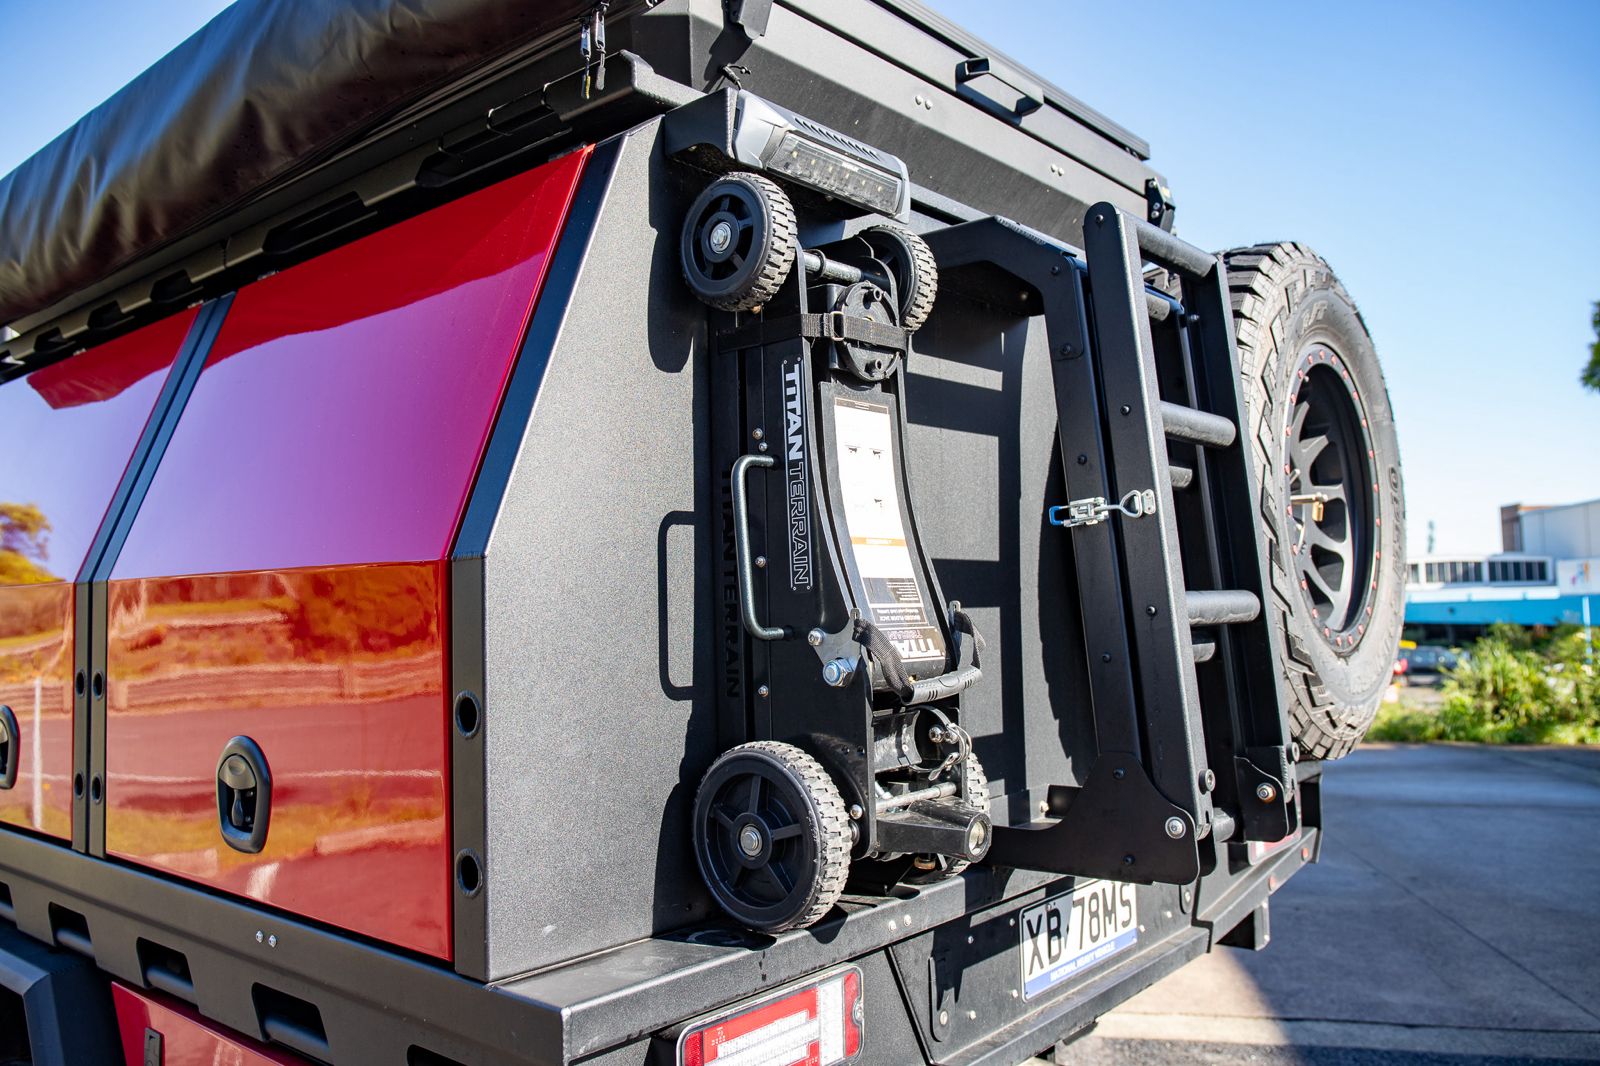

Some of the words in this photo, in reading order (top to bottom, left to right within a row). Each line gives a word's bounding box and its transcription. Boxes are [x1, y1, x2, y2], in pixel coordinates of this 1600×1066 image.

[784, 363, 804, 461] TITAN
[788, 462, 809, 585] TERRAIN
[723, 564, 740, 699] TERRAIN
[889, 638, 942, 659] TITA
[1026, 908, 1062, 976] XB
